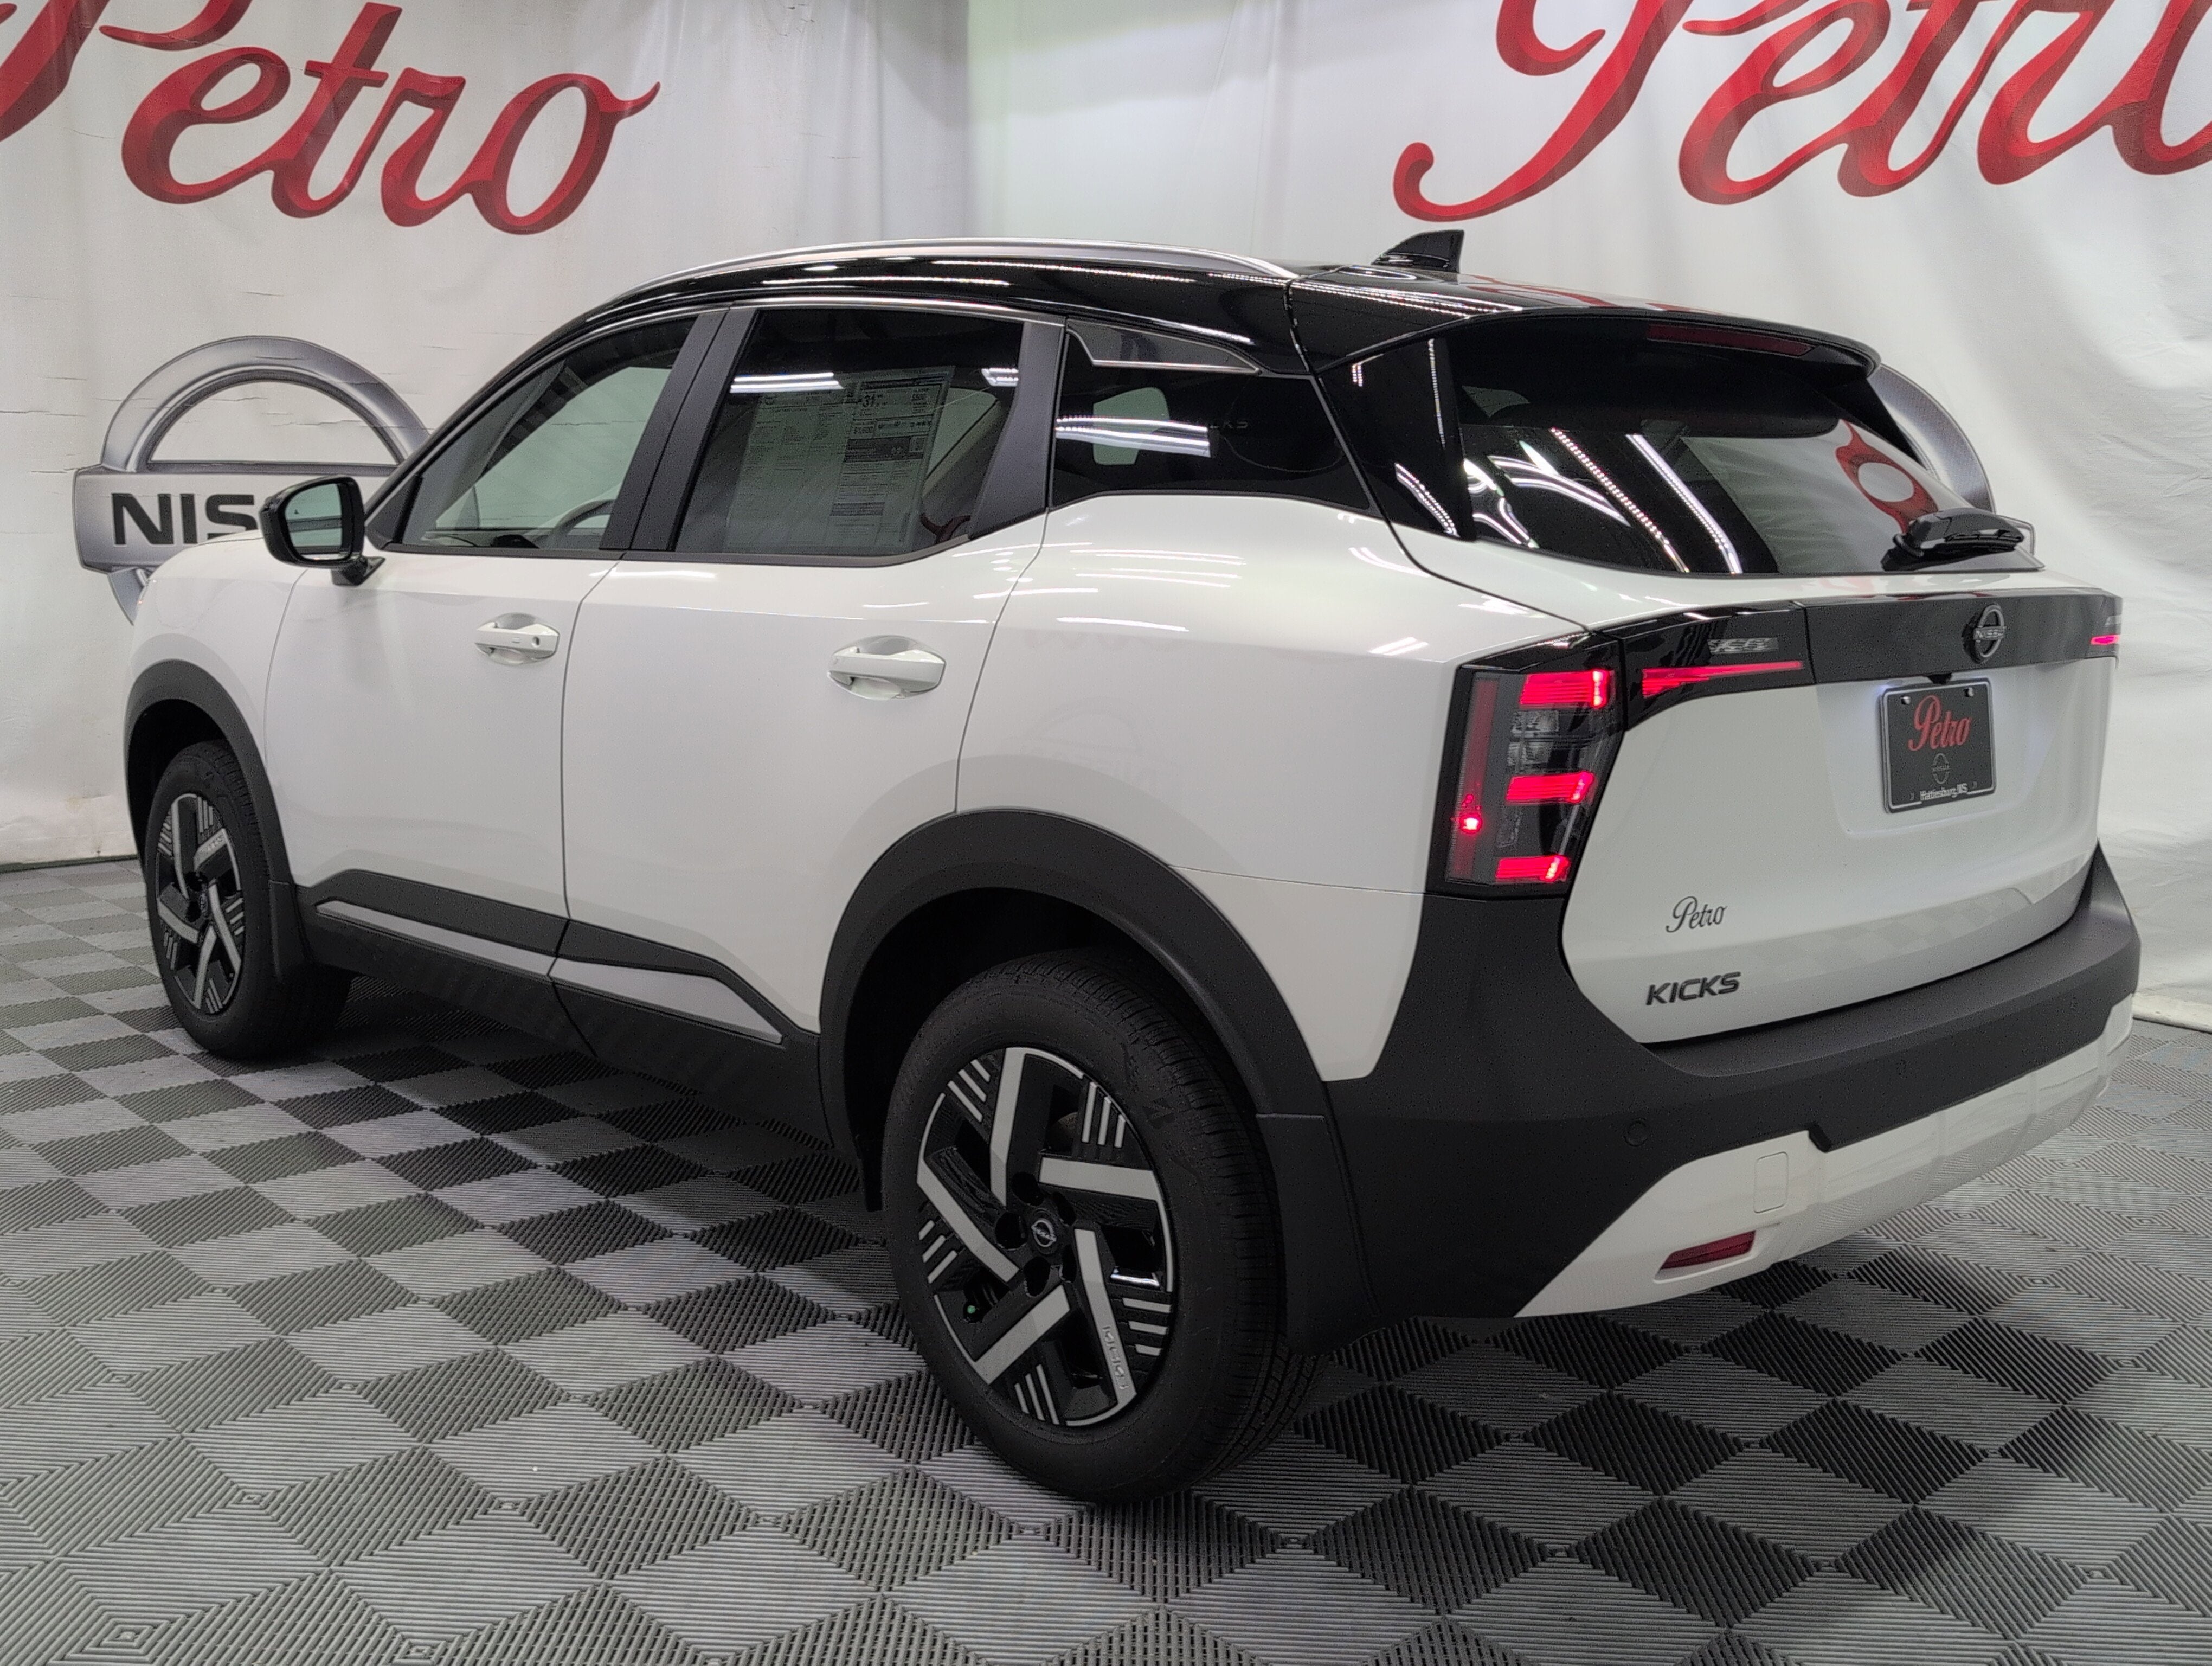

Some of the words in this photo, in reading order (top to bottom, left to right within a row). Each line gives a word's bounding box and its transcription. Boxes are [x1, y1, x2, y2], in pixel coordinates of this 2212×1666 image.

[1908, 695, 1972, 751] Petro
[1665, 896, 1728, 933] Petro
[1645, 971, 1741, 1005] KICKS
